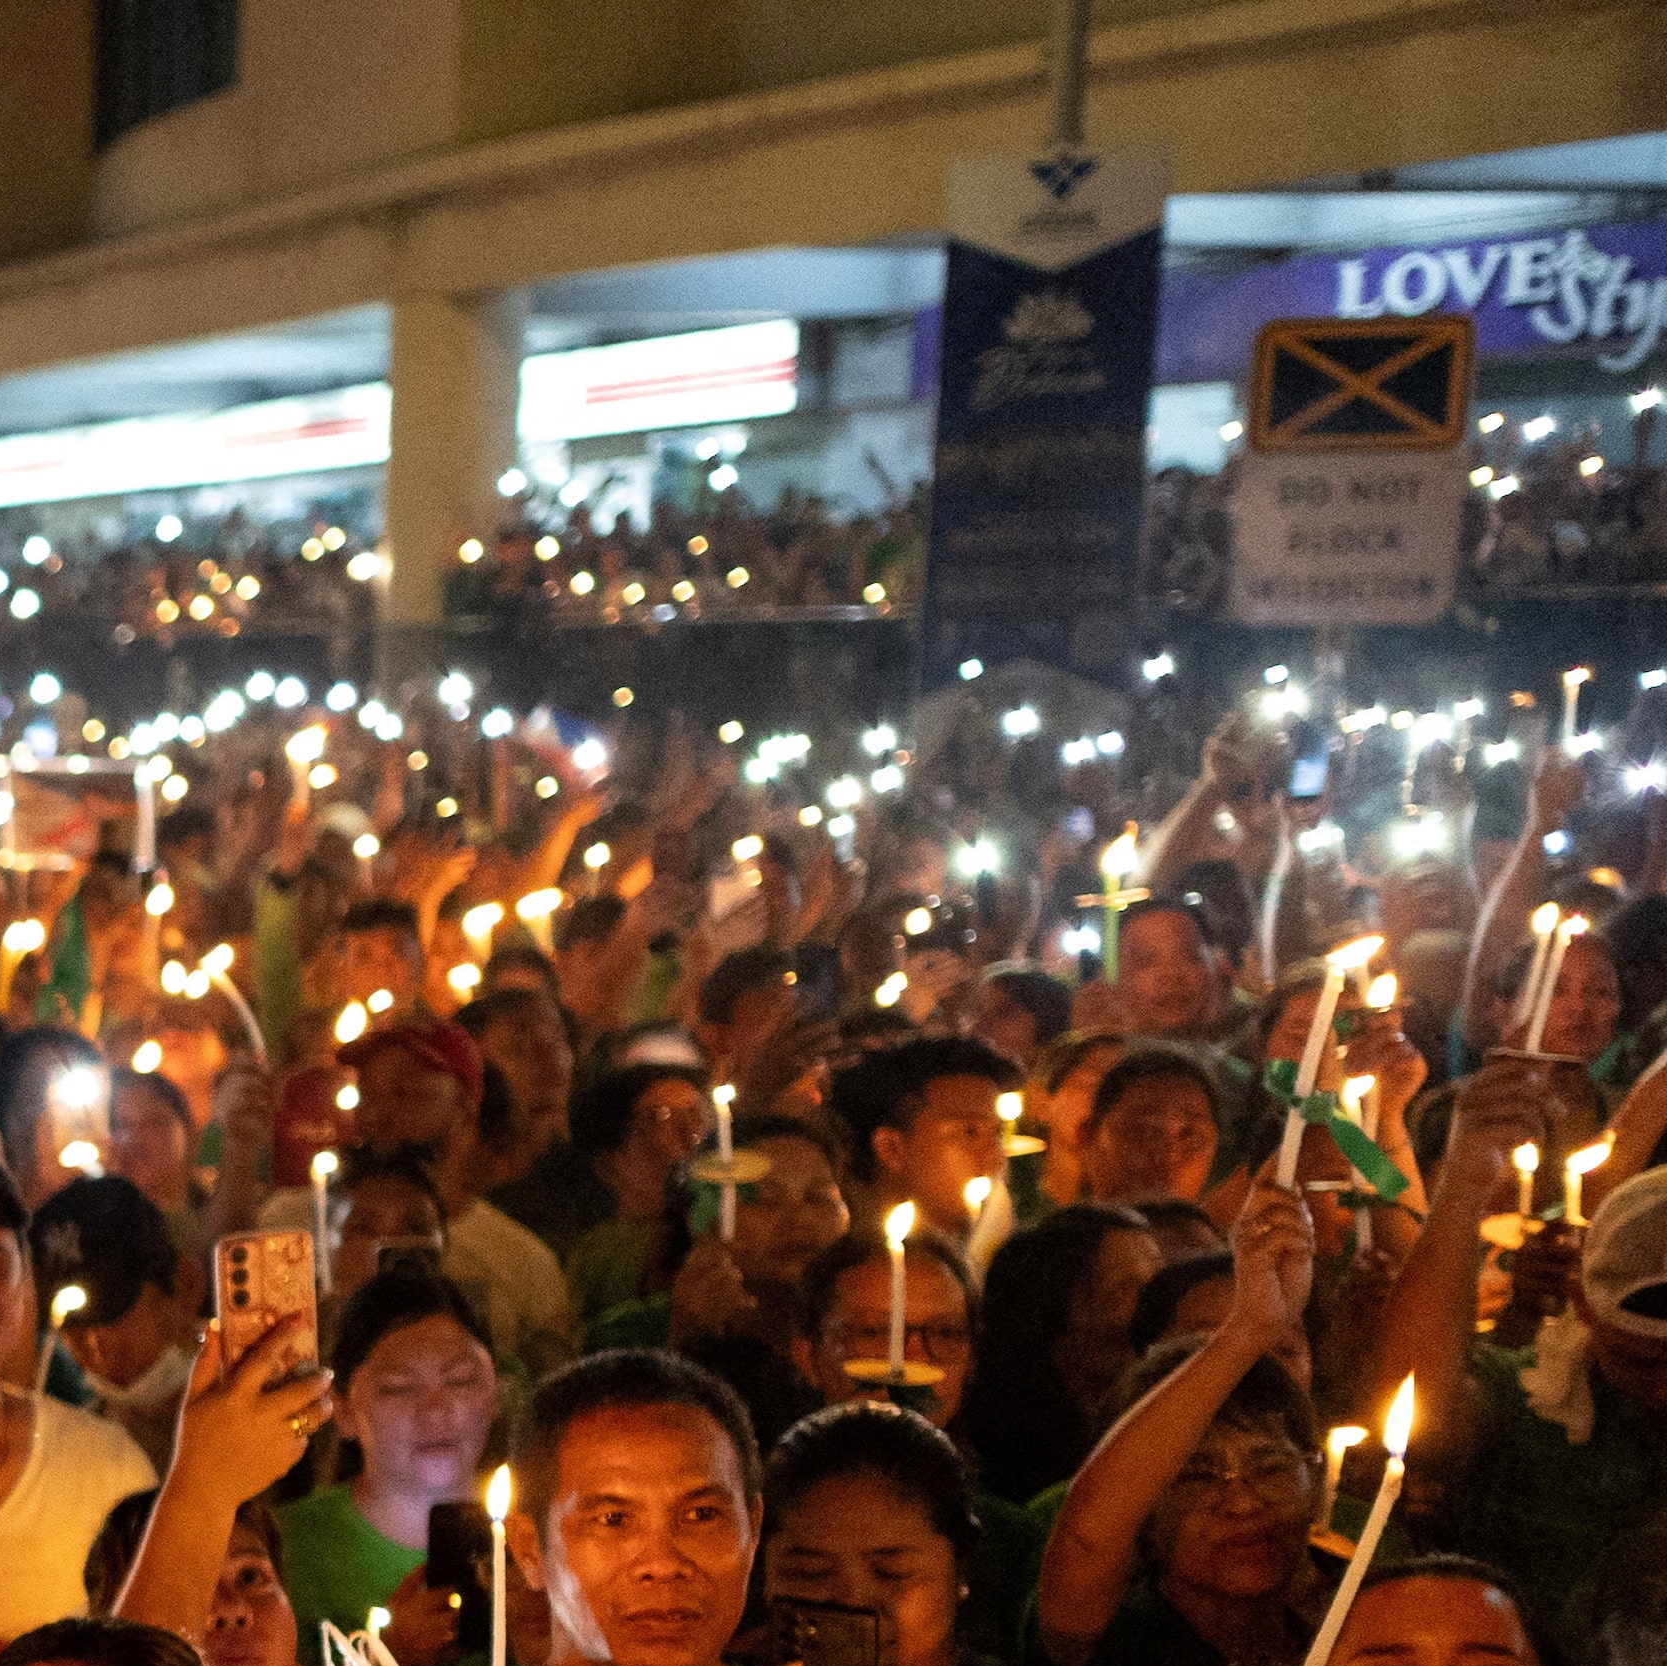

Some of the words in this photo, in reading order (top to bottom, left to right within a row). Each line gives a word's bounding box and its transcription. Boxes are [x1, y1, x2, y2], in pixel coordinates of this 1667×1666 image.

[1336, 238, 1560, 320] LOVE
[1277, 473, 1333, 508] DO
[1347, 468, 1425, 505] NOT
